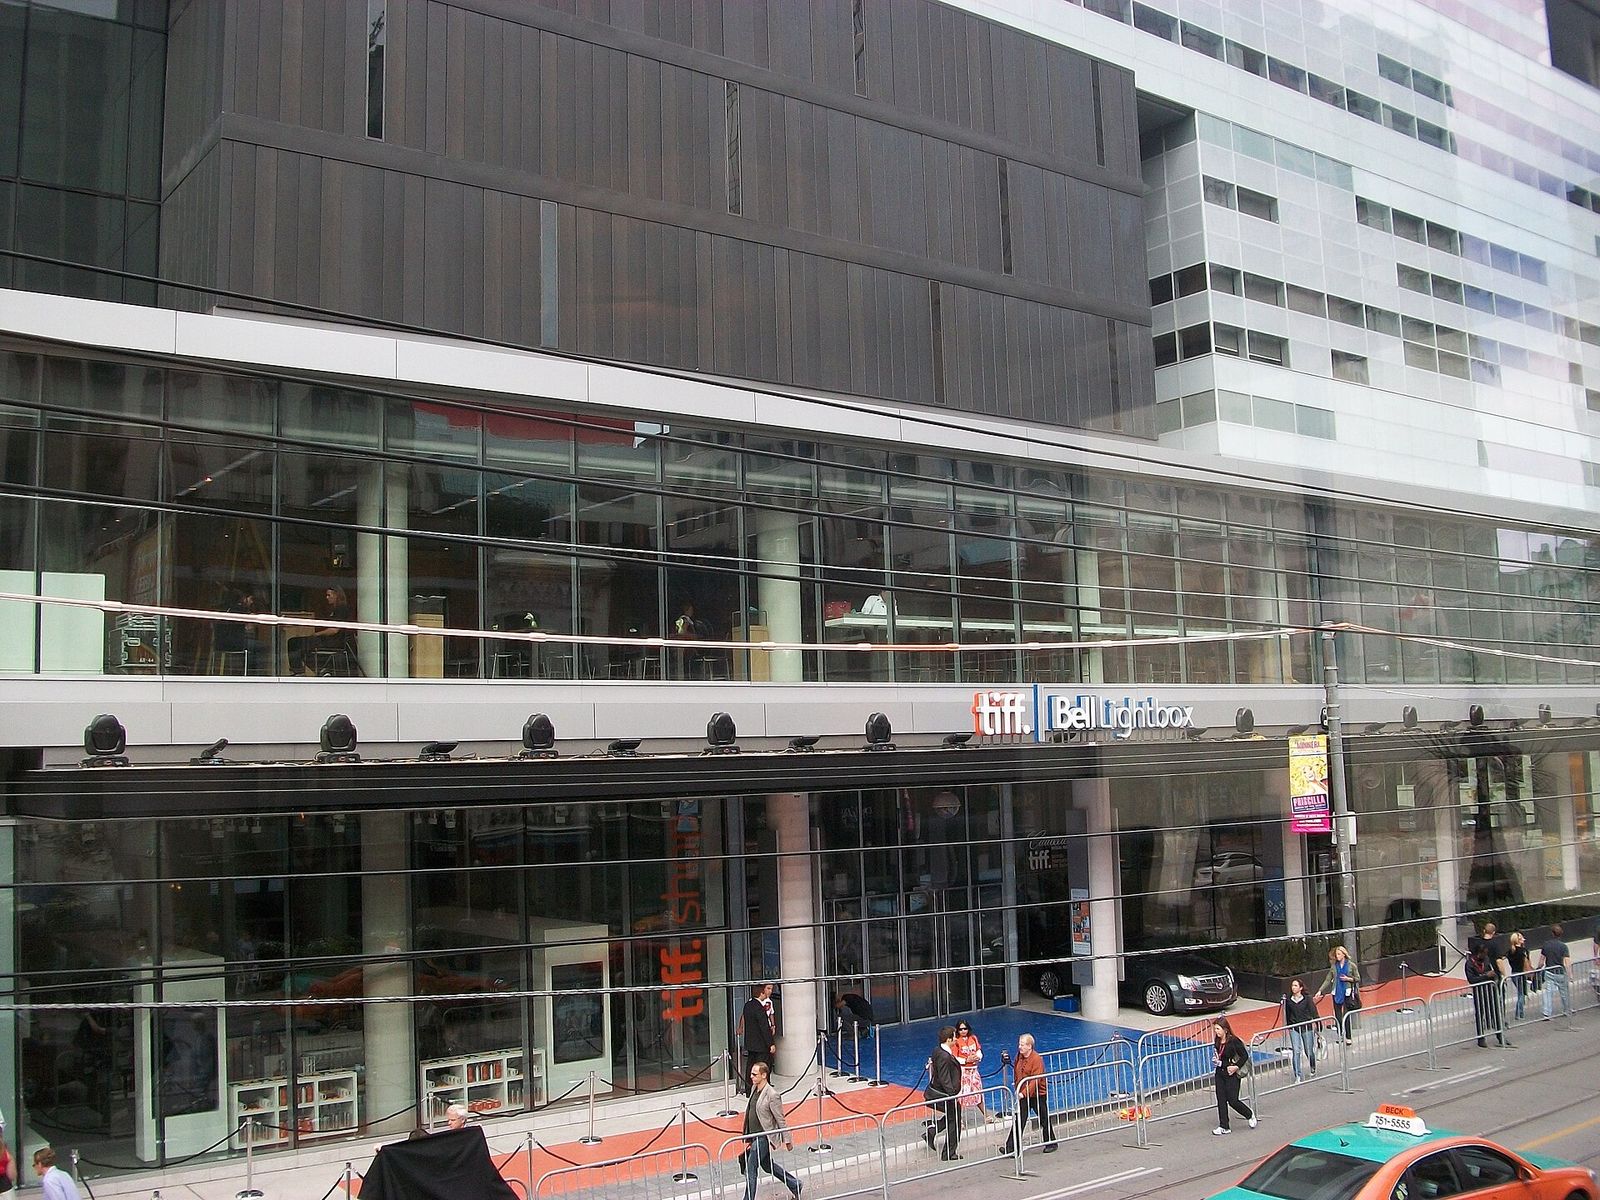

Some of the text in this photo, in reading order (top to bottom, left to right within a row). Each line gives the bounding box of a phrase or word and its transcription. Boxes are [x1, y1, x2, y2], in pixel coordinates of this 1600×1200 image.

[971, 691, 1195, 738] tiff. Bell Lightbox
[1293, 795, 1326, 807] PRISCILLA
[1028, 850, 1052, 871] tiff.
[660, 938, 704, 1023] tiff.
[1385, 1106, 1404, 1115] BECK
[1375, 1115, 1411, 1129] 751-5555
